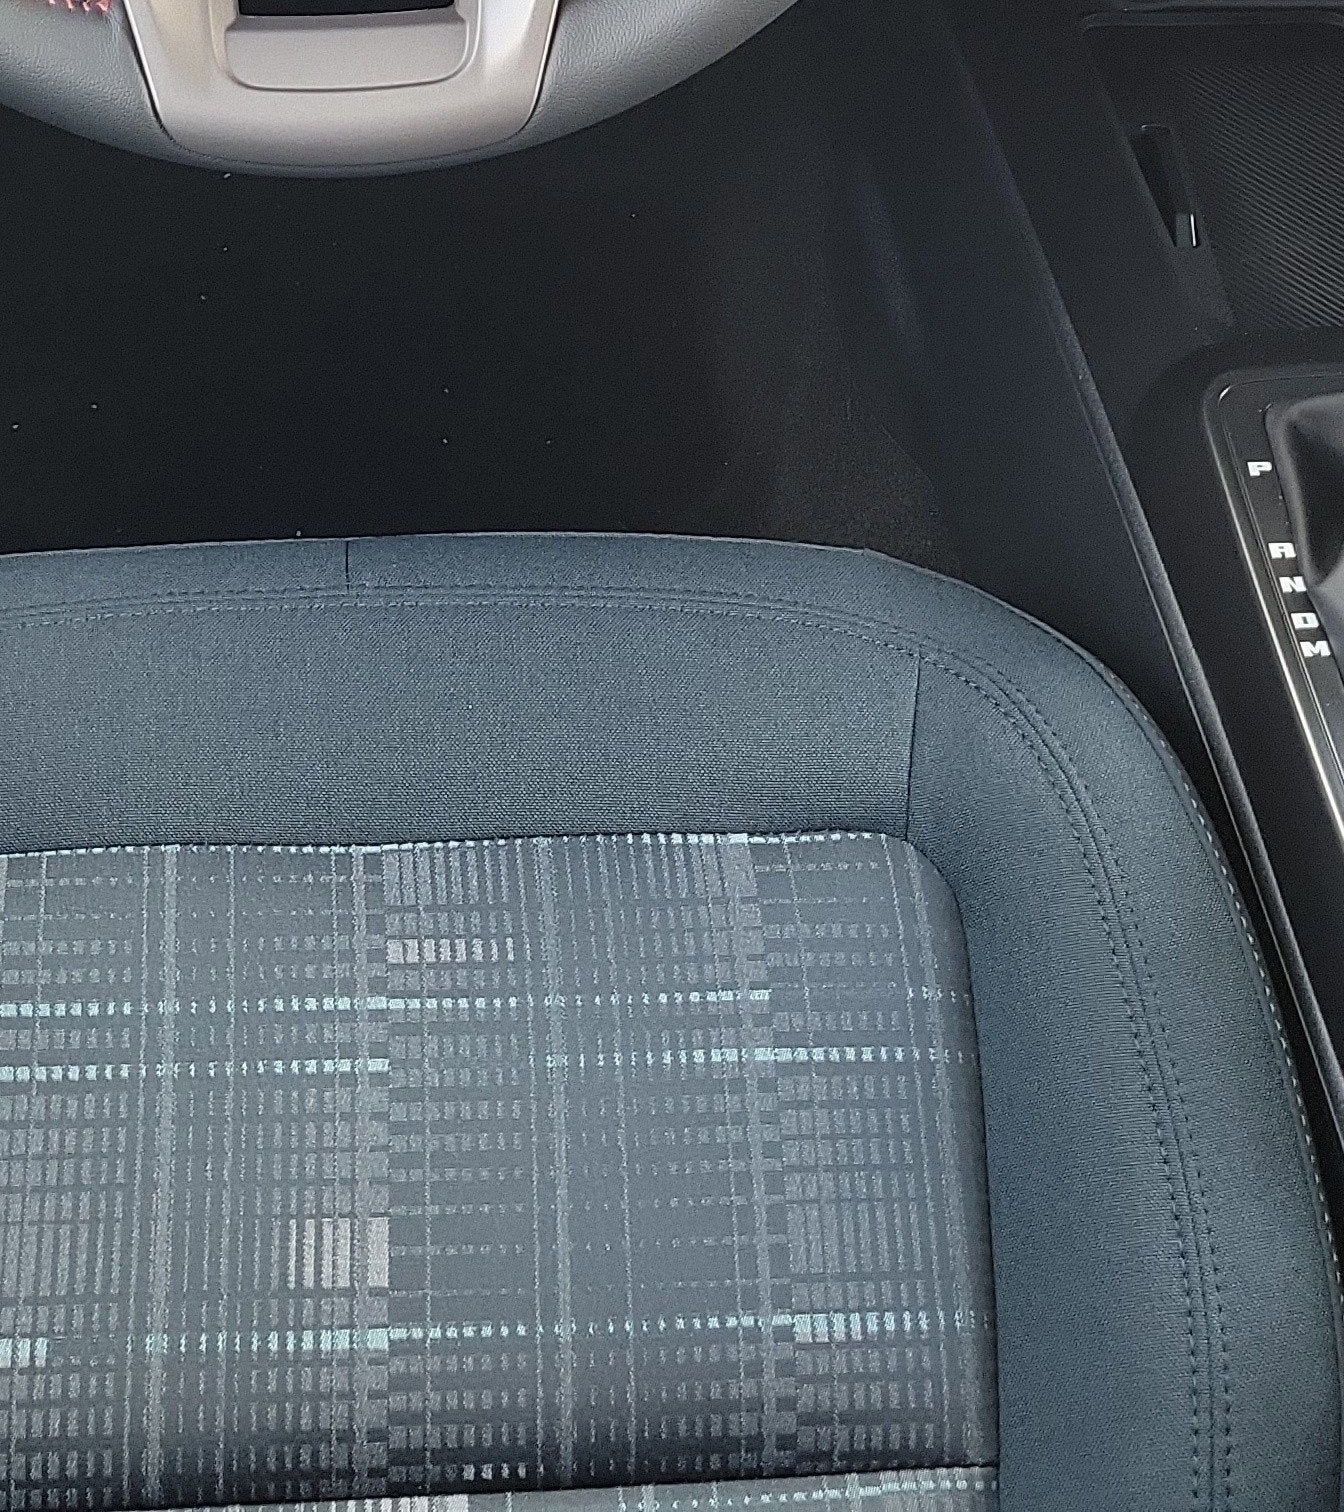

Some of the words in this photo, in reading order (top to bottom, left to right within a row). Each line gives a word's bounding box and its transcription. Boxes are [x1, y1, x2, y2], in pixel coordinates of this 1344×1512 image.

[1247, 460, 1273, 477] P
[1278, 576, 1307, 593] N
[1291, 612, 1320, 630] D
[1299, 640, 1331, 658] M
